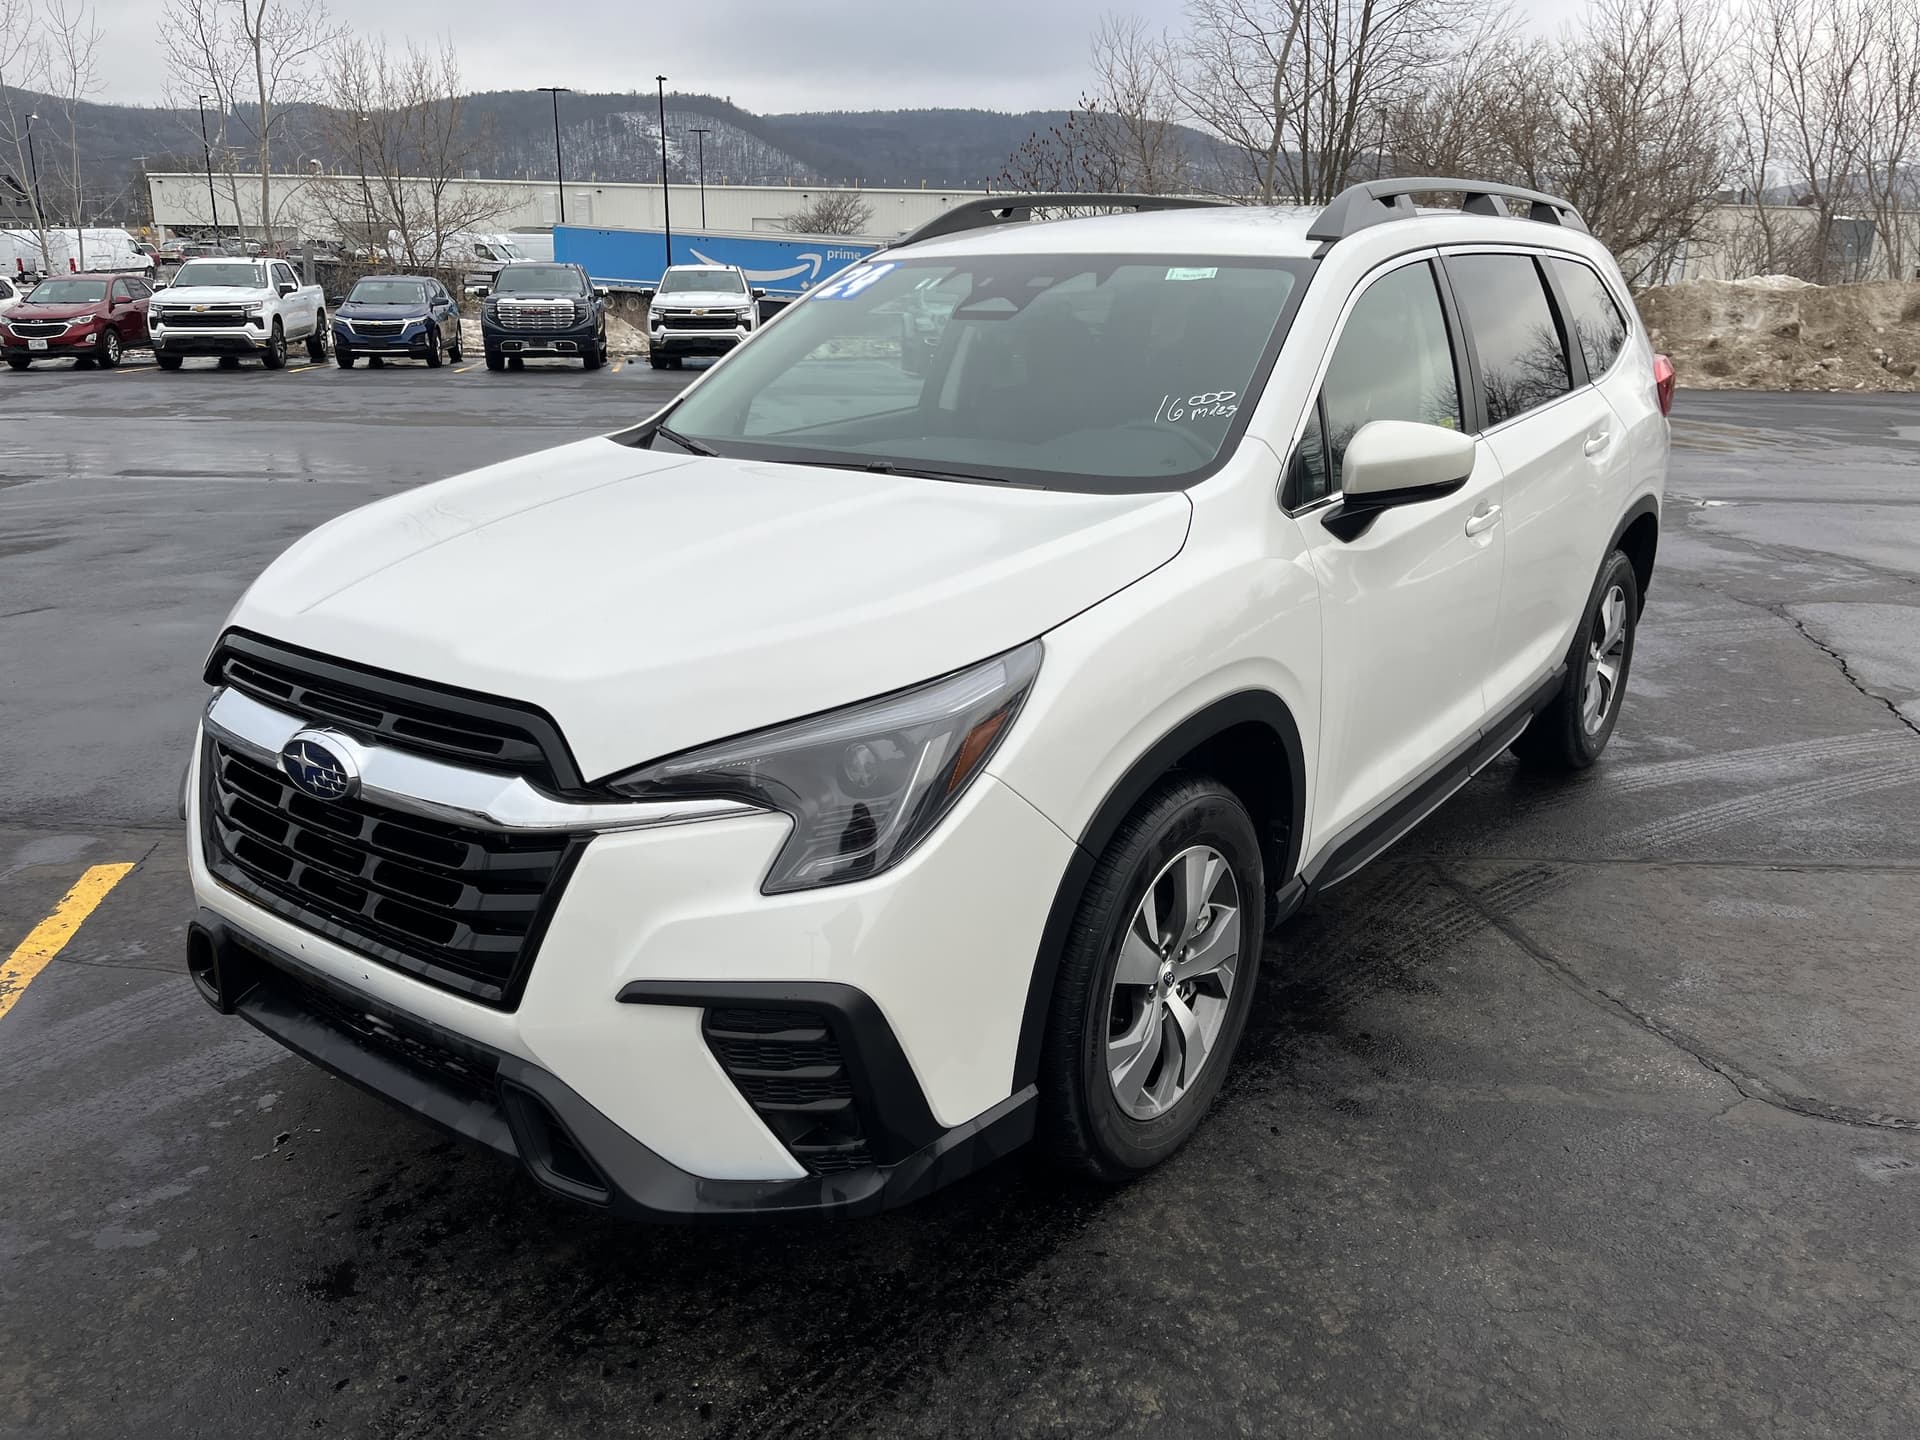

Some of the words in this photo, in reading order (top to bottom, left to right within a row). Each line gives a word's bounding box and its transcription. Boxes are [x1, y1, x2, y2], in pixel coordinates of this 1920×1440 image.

[827, 248, 861, 261] prime
[1154, 394, 1184, 423] 16
[1188, 391, 1237, 406] 000
